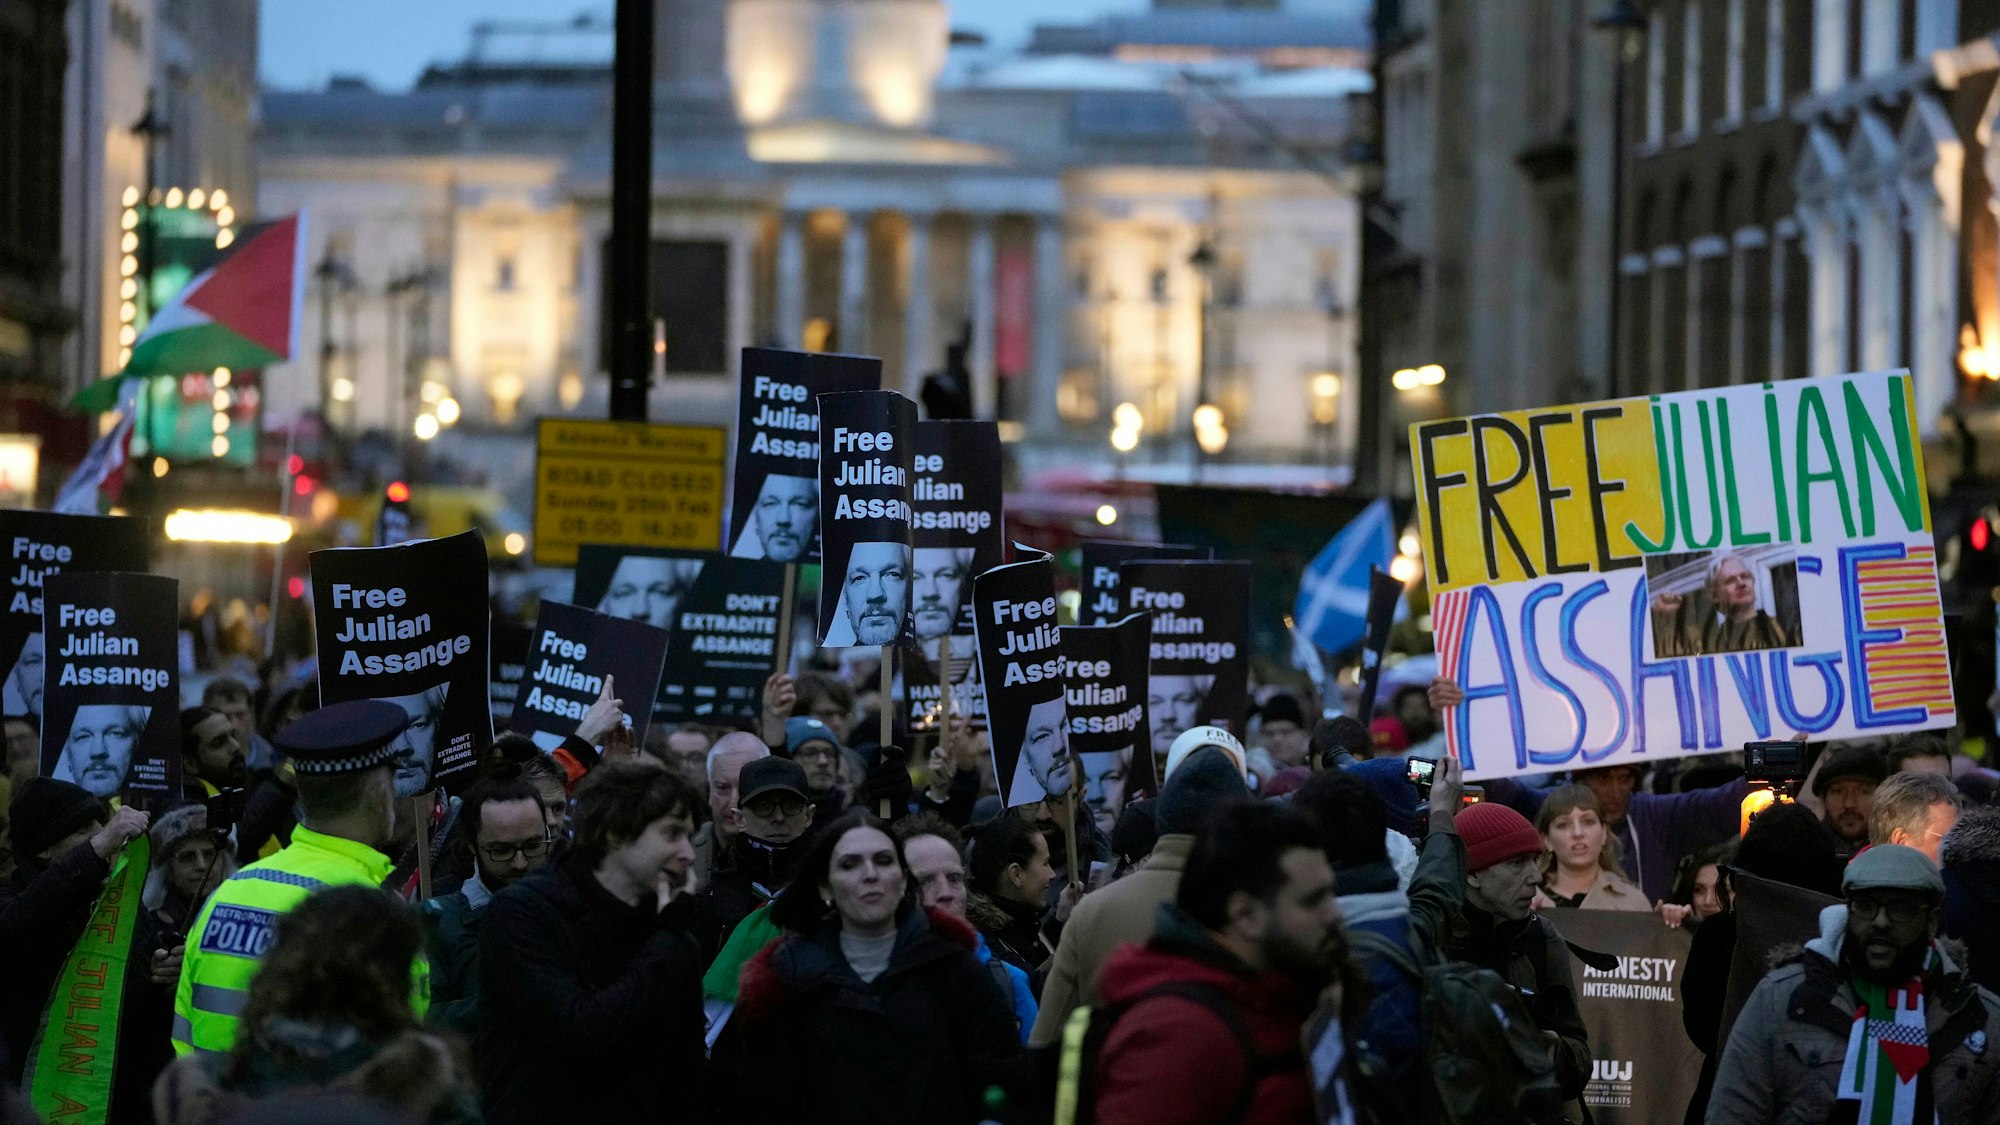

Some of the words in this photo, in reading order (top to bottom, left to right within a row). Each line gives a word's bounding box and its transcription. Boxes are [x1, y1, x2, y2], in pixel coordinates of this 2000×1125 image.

[754, 376, 808, 402] Free
[751, 431, 819, 460] Assa
[833, 427, 894, 453] Free
[913, 455, 943, 473] ee
[914, 477, 964, 501] lian
[1419, 407, 1643, 584] FREE
[1623, 375, 1924, 554] JULIAN
[914, 511, 991, 534] ssange
[12, 537, 72, 563] Free
[332, 584, 407, 609] Free
[726, 593, 779, 613] DON'T
[1130, 587, 1185, 608] Free
[60, 604, 116, 628] Free
[681, 612, 777, 634] EXTRADITE
[993, 597, 1056, 625] Free
[336, 613, 431, 643] Julian
[999, 622, 1061, 656] Julia
[60, 630, 138, 657] Julian
[339, 634, 471, 676] Assange
[540, 630, 587, 661] Free
[691, 635, 774, 656] ASSANGE
[1151, 642, 1236, 664] ssange
[59, 663, 170, 693] Assange
[533, 659, 602, 695] Julian
[1065, 659, 1111, 678] ree
[1064, 682, 1127, 706] ulian
[437, 741, 471, 758] EXTRADITE
[451, 733, 471, 745] DON'T
[442, 750, 472, 765] ASSANGE
[214, 908, 277, 925] METROPOLI
[202, 918, 274, 955] POLIC
[1583, 982, 1675, 1002] INTERNATIONAL
[56, 957, 109, 1076] JULIAN
[1584, 1095, 1632, 1105] OURNALISTS
